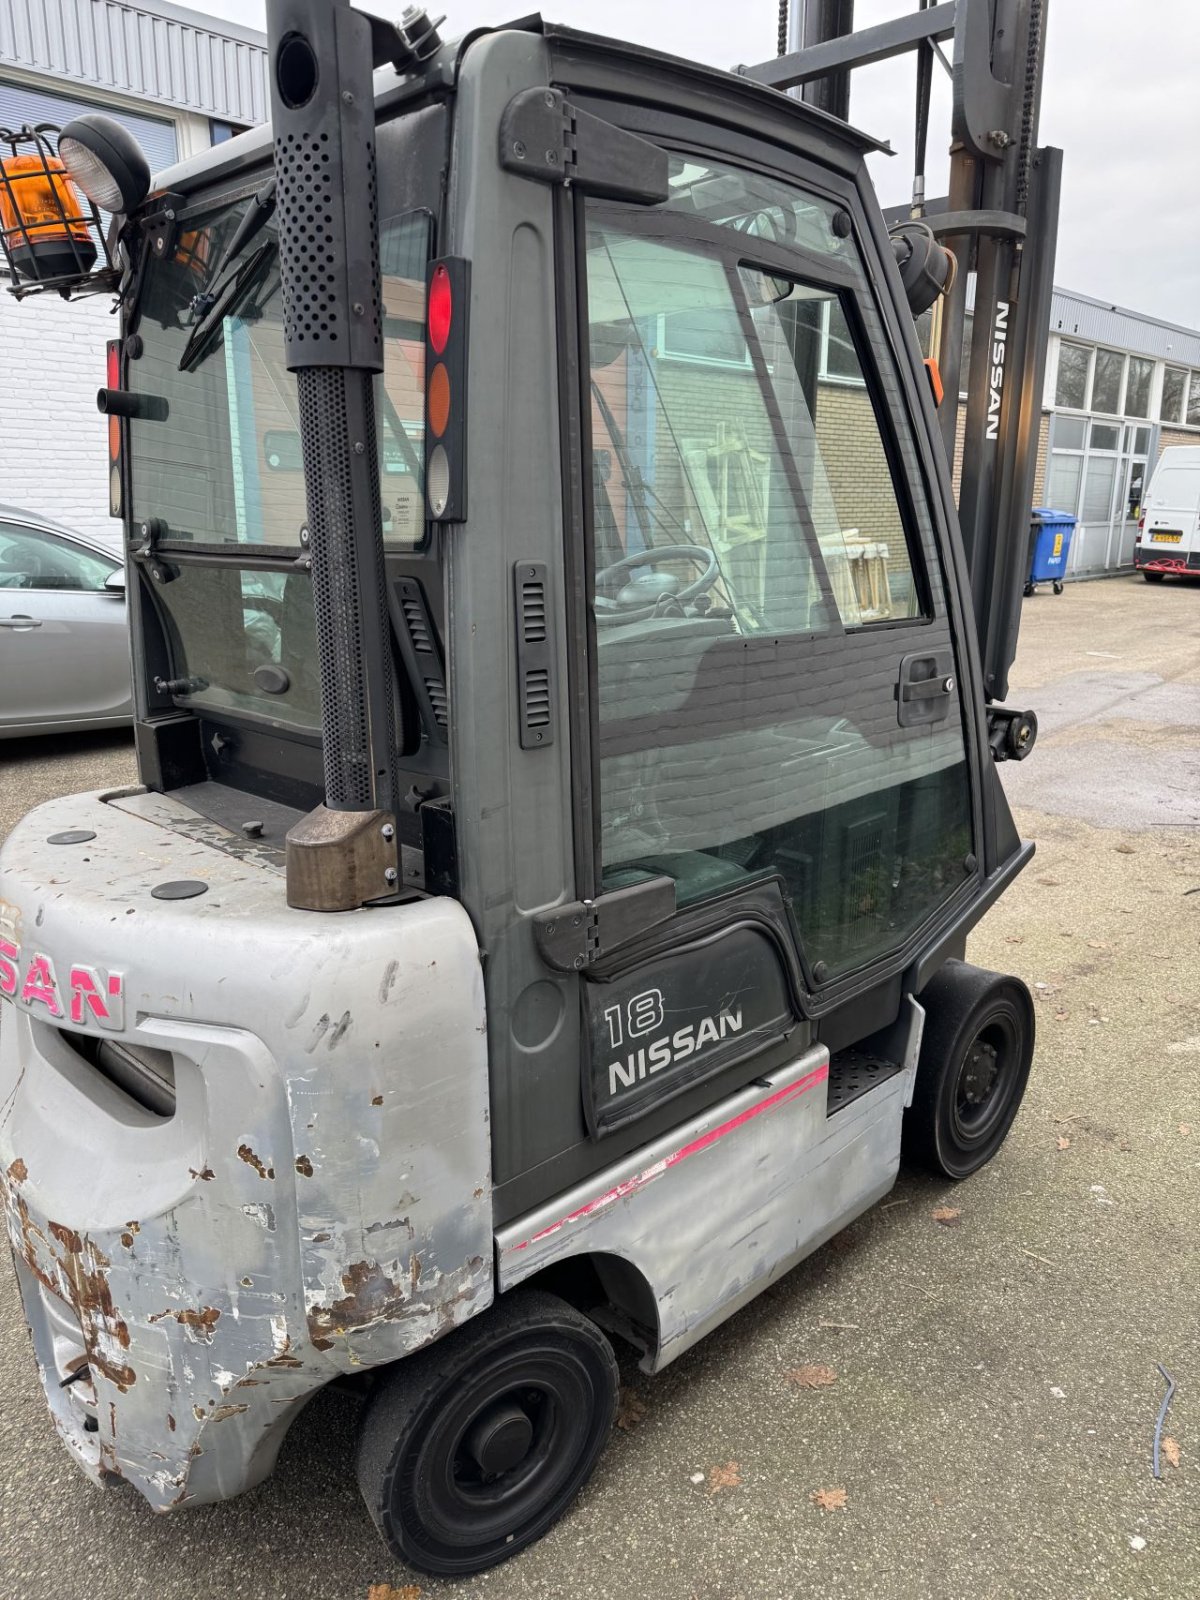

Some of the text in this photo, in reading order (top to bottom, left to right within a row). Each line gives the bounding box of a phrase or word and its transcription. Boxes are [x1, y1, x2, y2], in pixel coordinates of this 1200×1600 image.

[986, 301, 1010, 440] NISSAN
[604, 988, 664, 1049] 18
[609, 1004, 743, 1095] NISSAN
